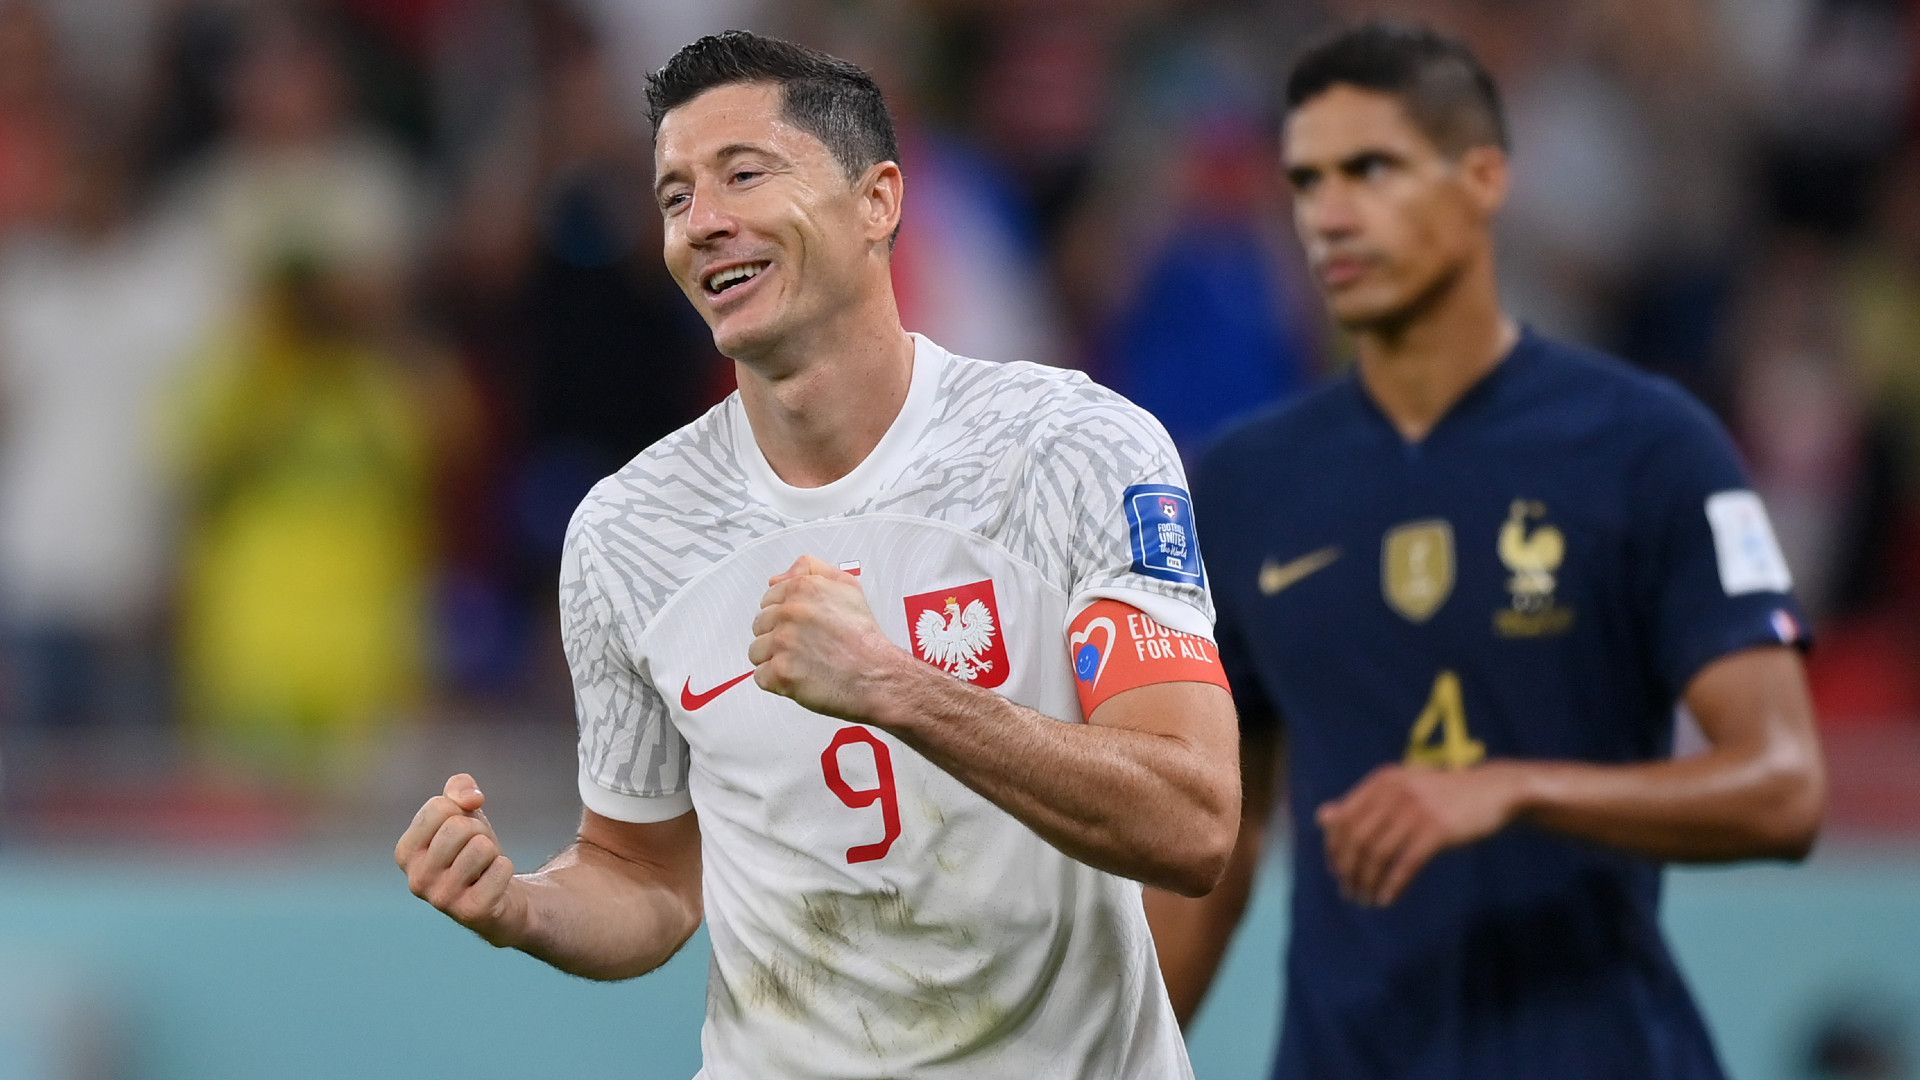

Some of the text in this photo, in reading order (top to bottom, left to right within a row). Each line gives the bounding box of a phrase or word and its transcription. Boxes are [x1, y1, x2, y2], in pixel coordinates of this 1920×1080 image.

[1159, 532, 1186, 547] UNITES
[1135, 639, 1213, 664] FOR ALL
[1403, 671, 1486, 767] 4
[821, 725, 901, 865] 9
